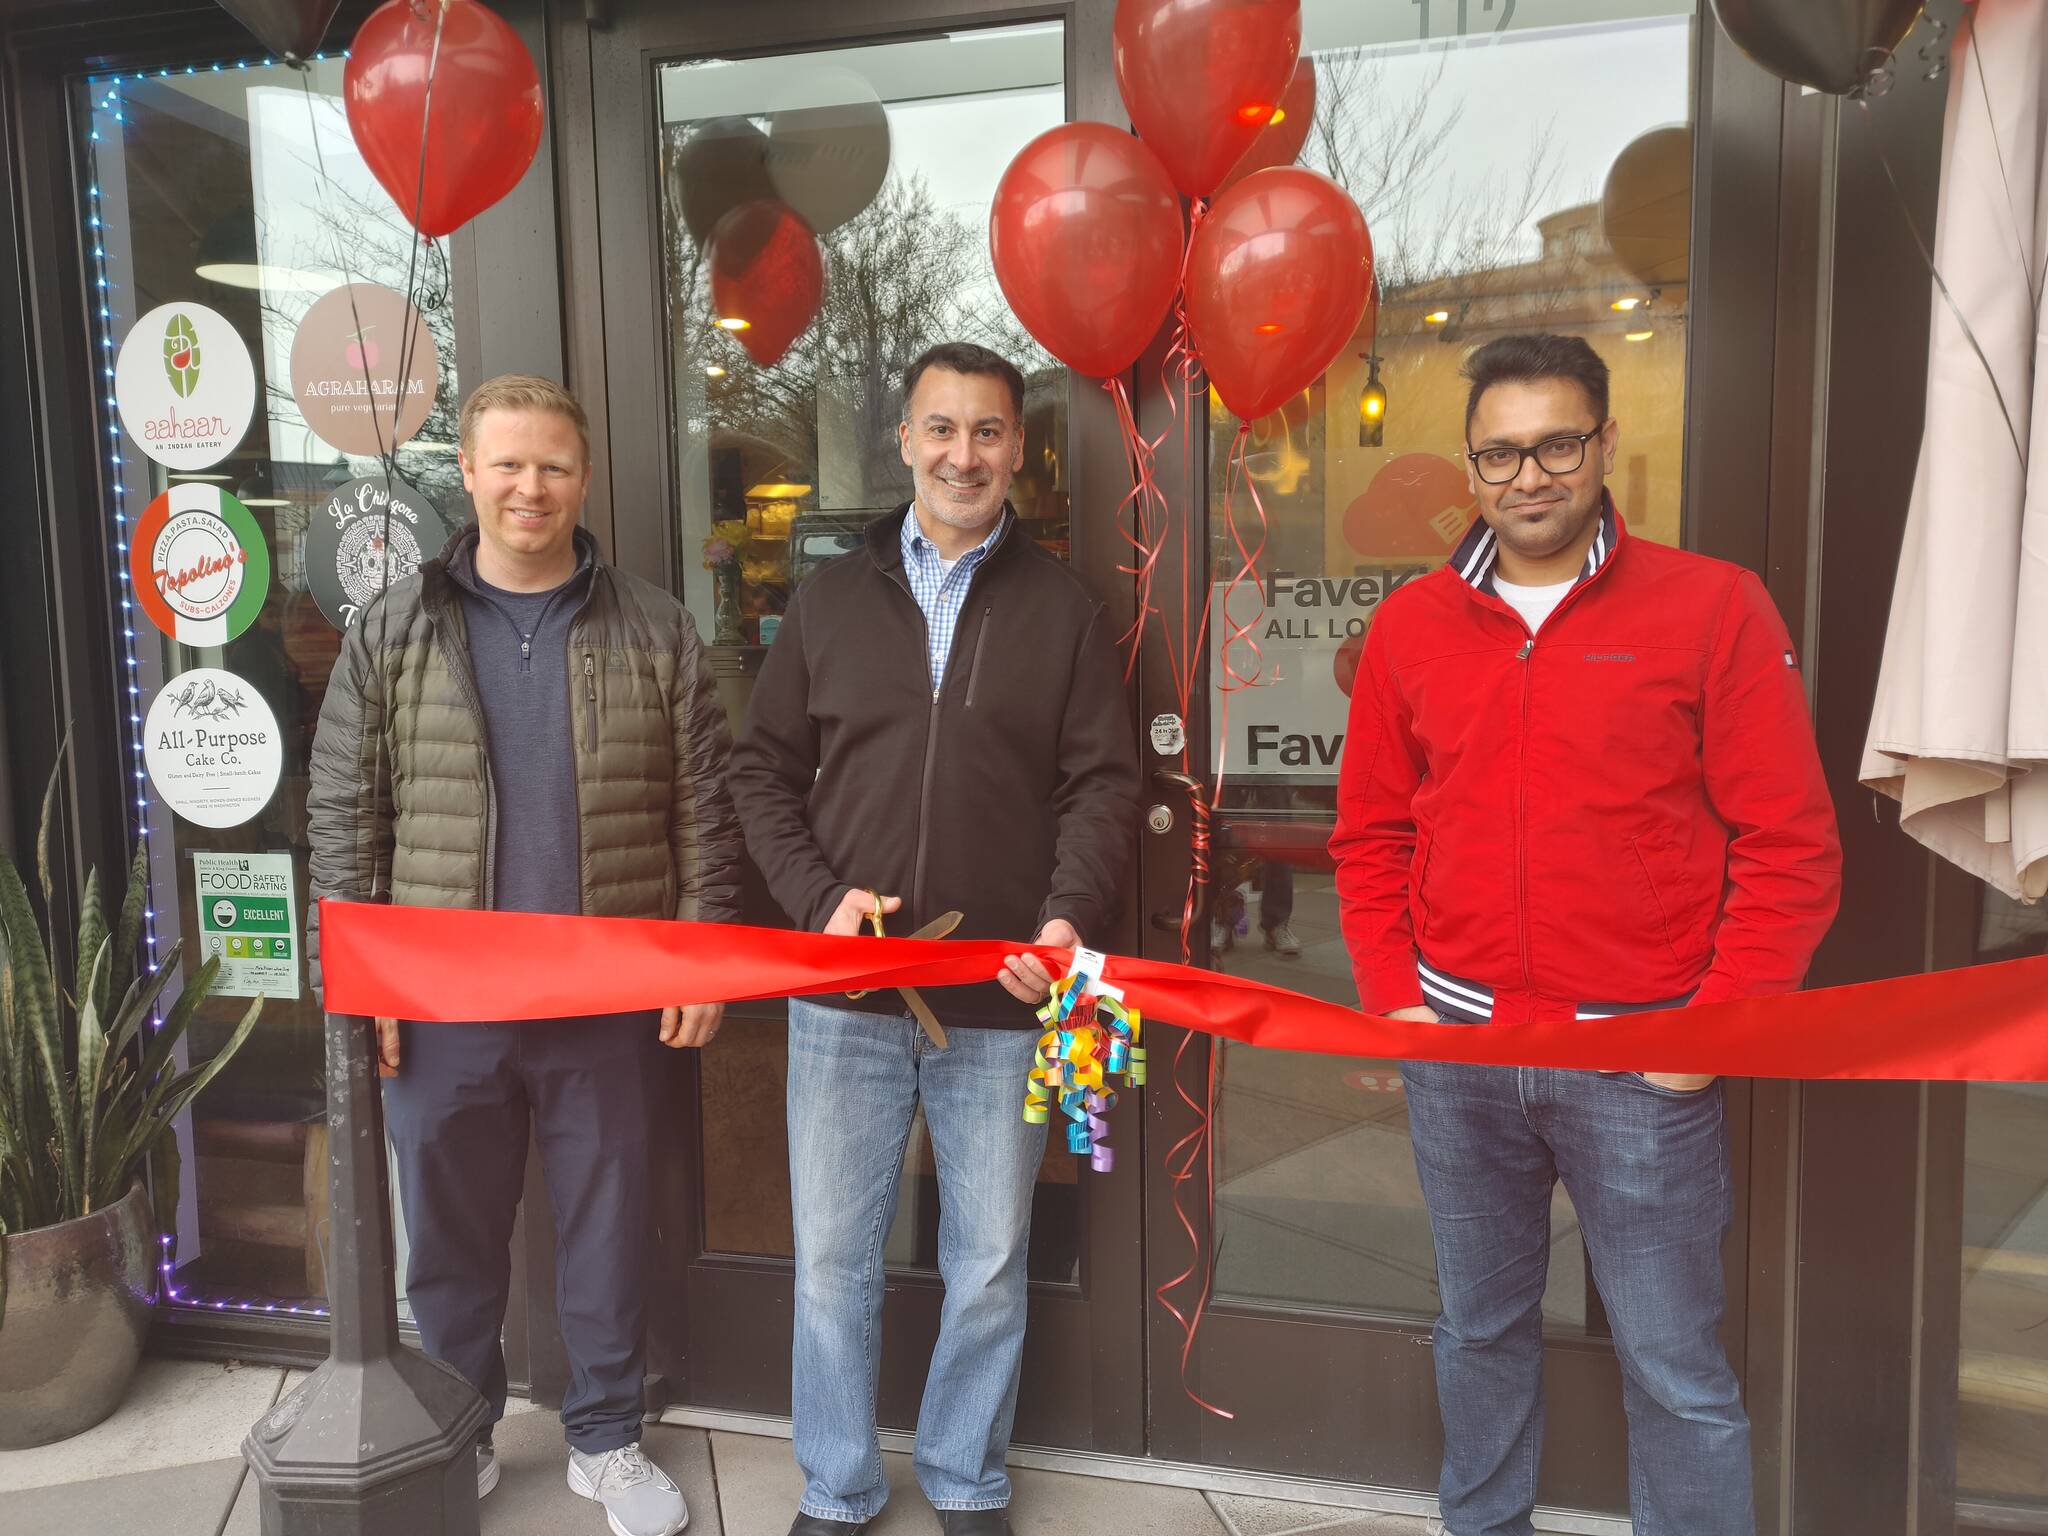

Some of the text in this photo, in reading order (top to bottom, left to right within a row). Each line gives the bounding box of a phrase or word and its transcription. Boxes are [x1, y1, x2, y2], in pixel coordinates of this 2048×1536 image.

[304, 379, 424, 397] AGRAHARAM
[330, 402, 403, 414] pure vegtaria
[144, 405, 231, 440] aahaar
[328, 497, 358, 530] La
[153, 541, 248, 597] Topolino's
[1266, 567, 1428, 608] FaveK
[1264, 618, 1319, 639] ALL
[158, 728, 267, 752] All-Purpose
[185, 752, 241, 767] Cake Co.
[200, 873, 286, 890] FOOD SAFETY
[253, 882, 287, 891] RATING
[243, 908, 284, 920] EXCELLENT
